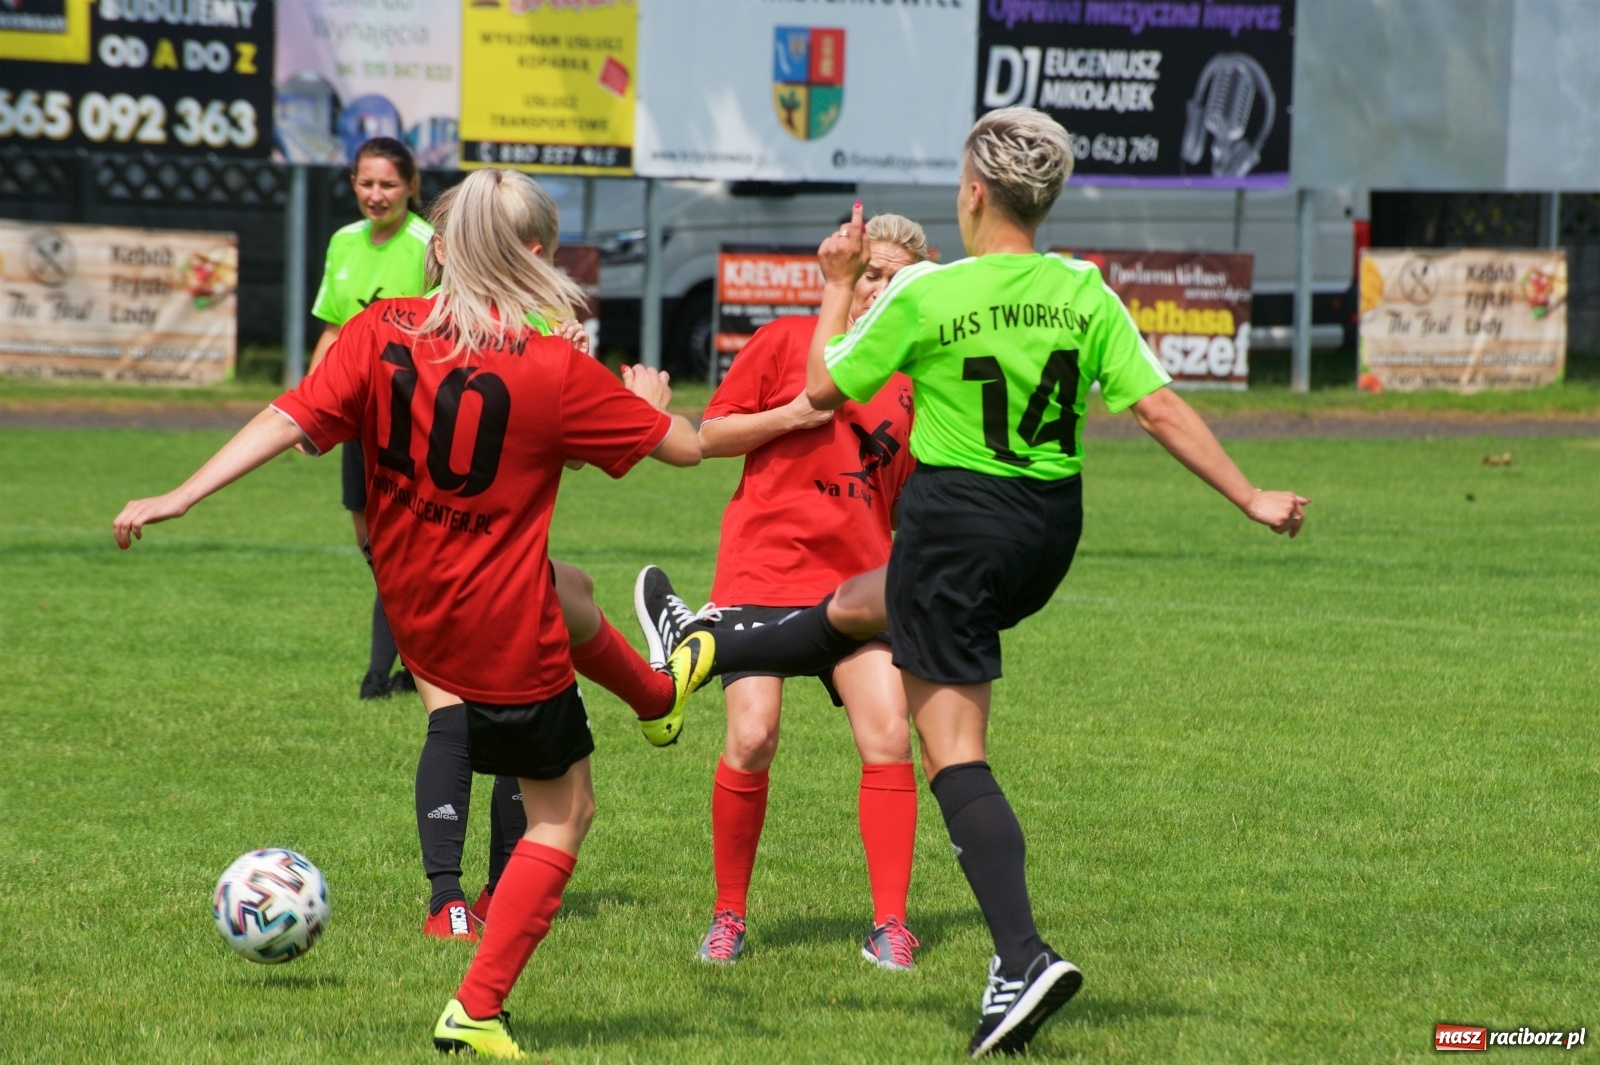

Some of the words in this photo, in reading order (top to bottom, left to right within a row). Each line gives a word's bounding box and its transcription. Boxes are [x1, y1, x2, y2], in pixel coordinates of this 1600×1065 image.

[99, 0, 257, 28] BUDUJEMY
[988, 0, 1080, 30] Oprawa
[1084, 1, 1199, 35] muzyczna
[1203, 0, 1281, 38] imprez
[98, 34, 149, 68] OD
[152, 38, 179, 70] A
[182, 40, 231, 73] DO
[234, 42, 258, 74] Z
[1043, 48, 1162, 80] EUGENIUSZ
[983, 46, 1042, 109] DJ
[1039, 80, 1156, 113] MIKOŁAJEK
[78, 91, 168, 144] 092
[172, 97, 259, 149] 363
[1090, 133, 1127, 164] 623
[939, 312, 981, 346] LKS
[990, 303, 1092, 335] TWORKÓW
[1160, 321, 1252, 377] szef
[378, 341, 511, 498] 10
[962, 349, 1081, 467] 14
[813, 479, 841, 497] Va
